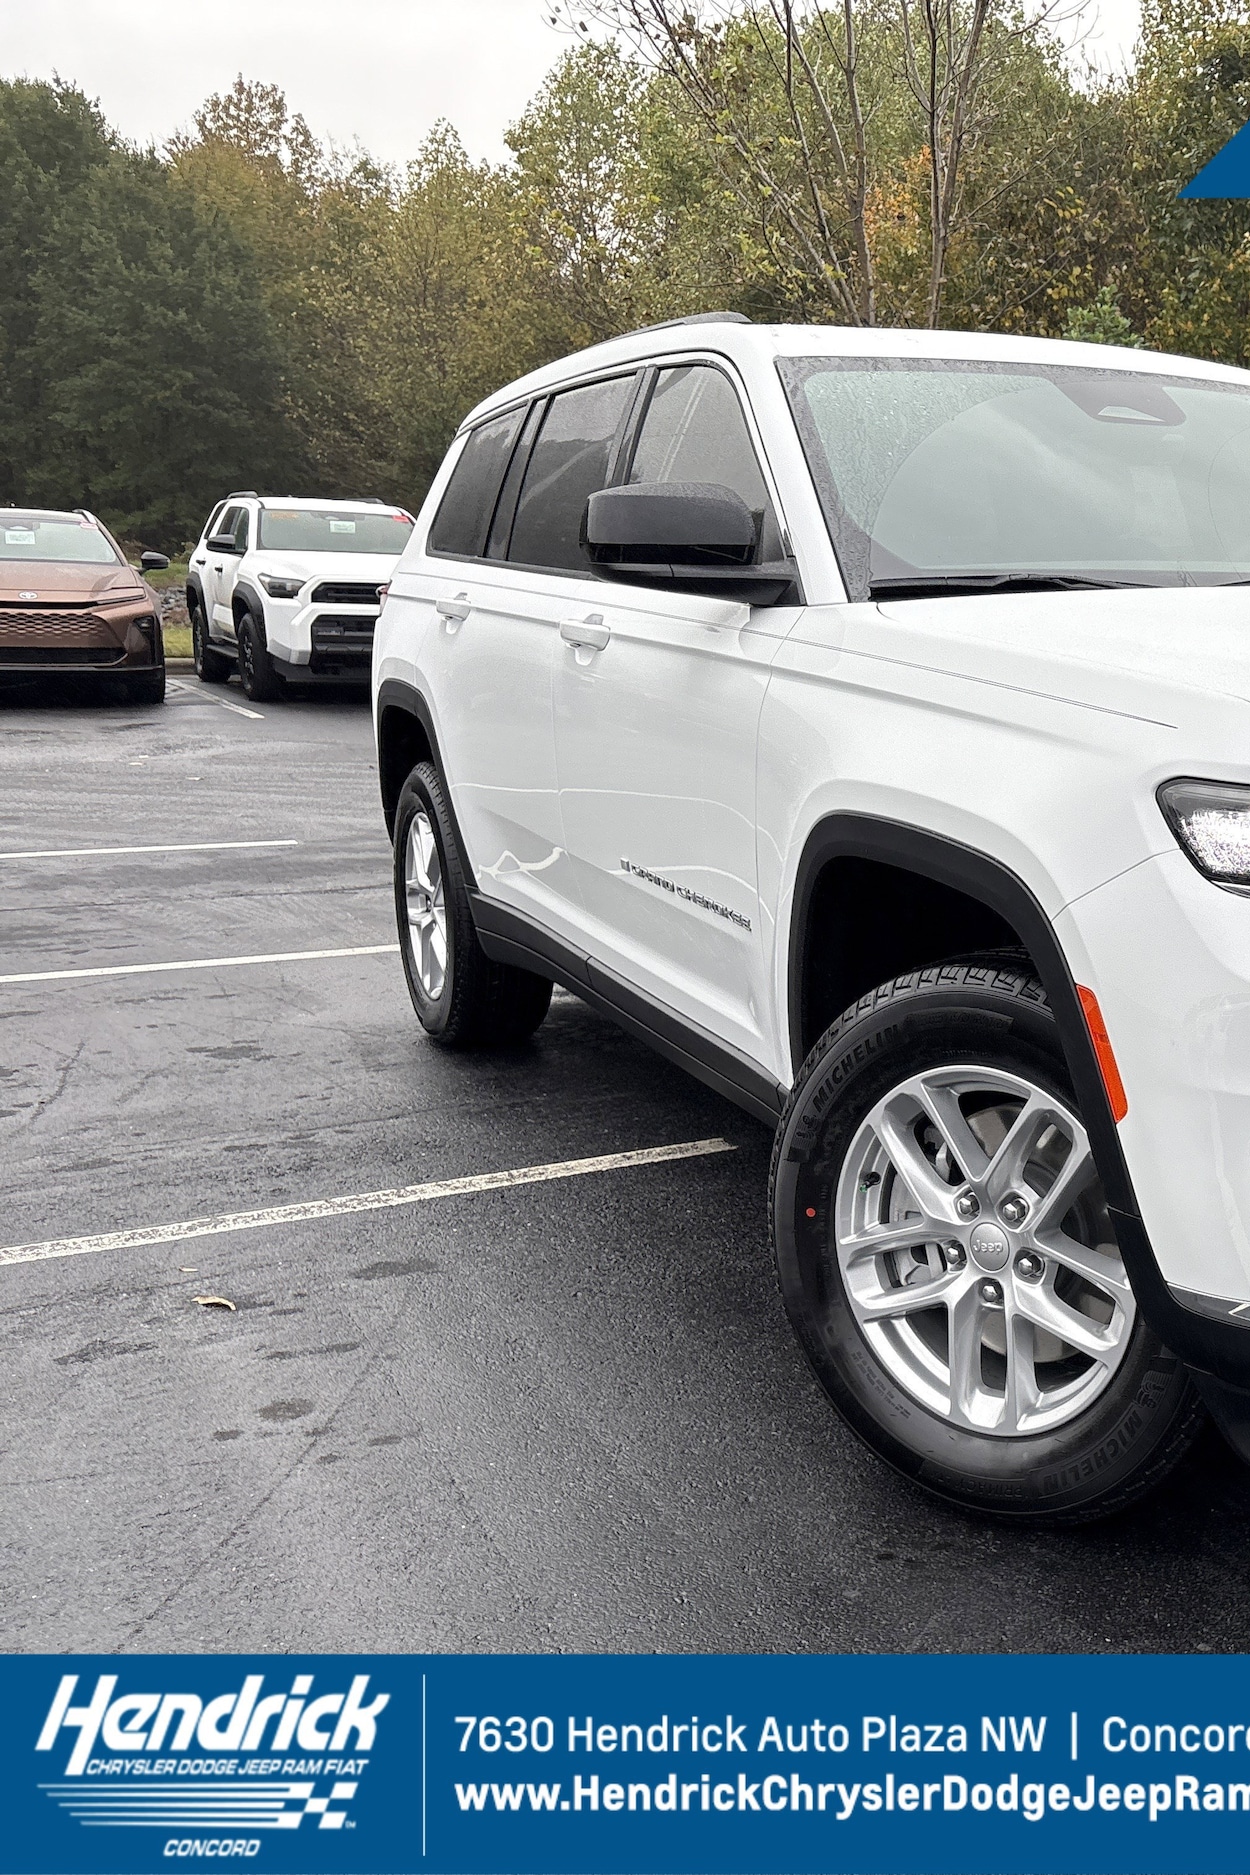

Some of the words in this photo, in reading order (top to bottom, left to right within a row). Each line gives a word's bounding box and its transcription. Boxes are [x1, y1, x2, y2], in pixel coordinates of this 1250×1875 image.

[813, 1024, 900, 1113] MICHELIN
[972, 1239, 1004, 1256] Jeep
[1043, 1409, 1143, 1496] MICHELIN
